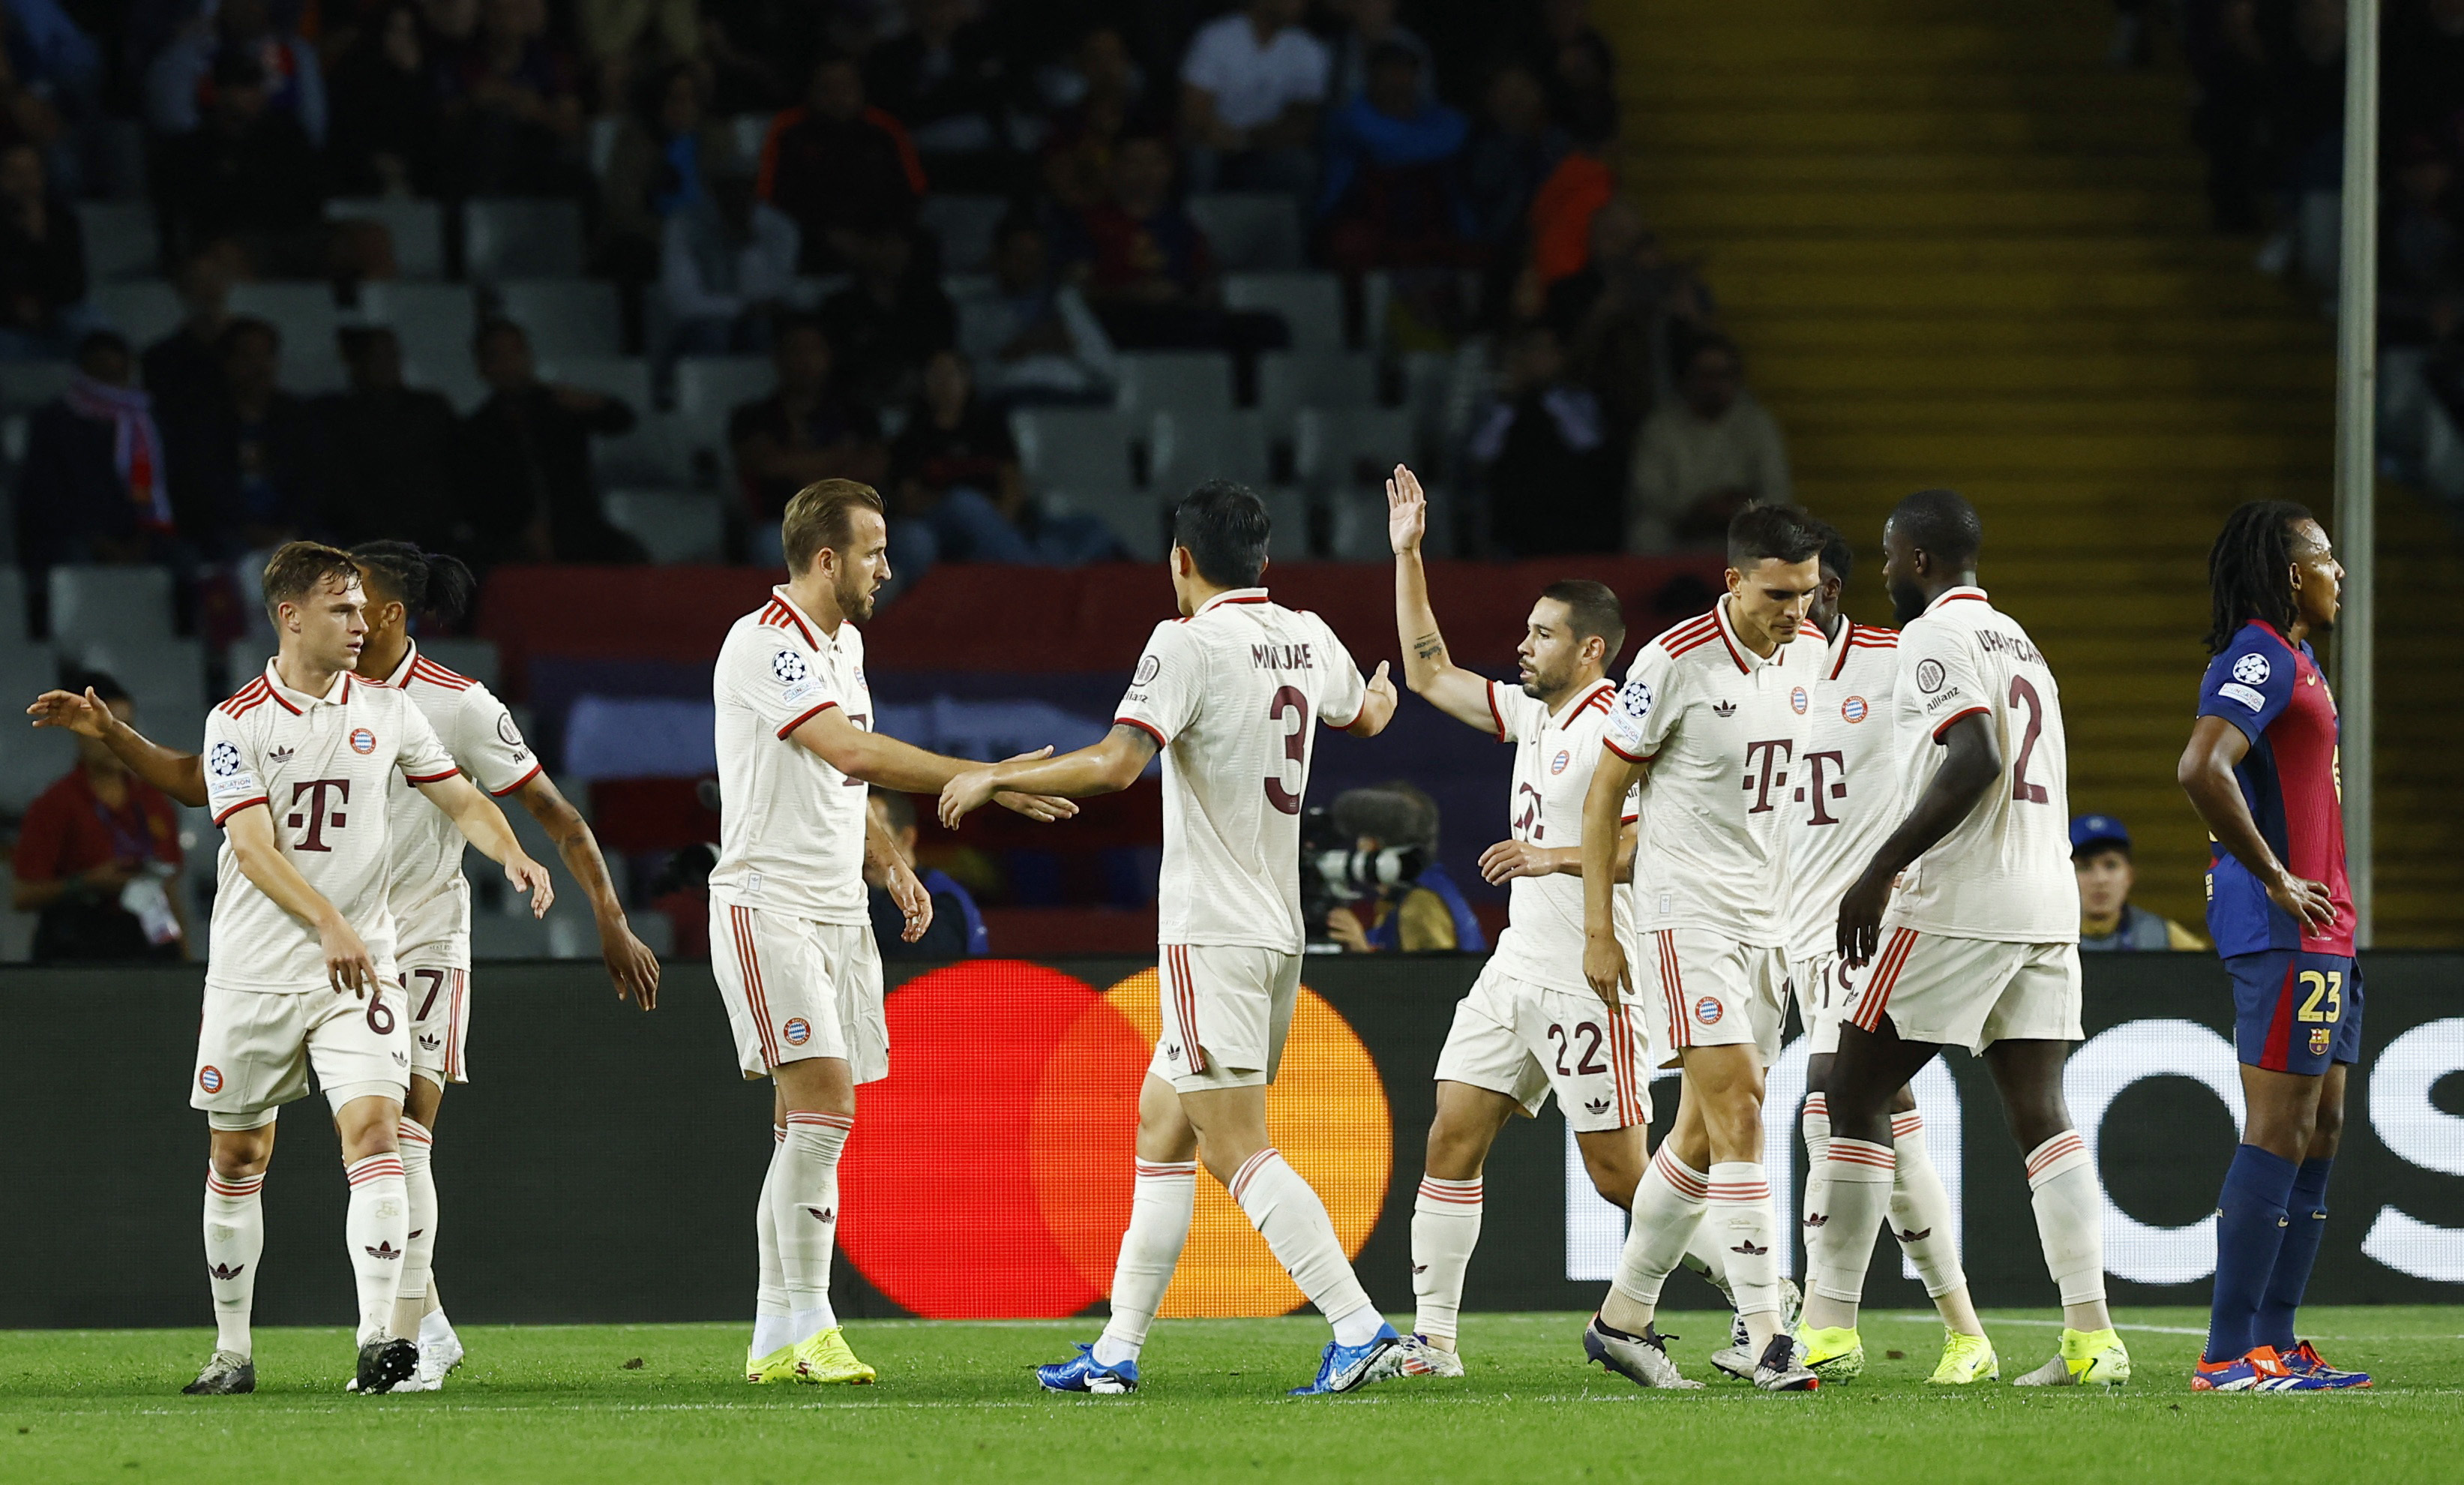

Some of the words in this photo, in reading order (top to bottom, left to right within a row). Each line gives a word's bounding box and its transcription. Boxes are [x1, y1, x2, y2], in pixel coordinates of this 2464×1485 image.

[1251, 644, 1313, 670] MINJAE
[1926, 686, 1960, 714] Allianz
[1263, 686, 1308, 815] 3
[2009, 674, 2049, 806] 2
[1743, 739, 1793, 814] T
[1794, 750, 1847, 826] T
[288, 779, 350, 852] T
[367, 992, 395, 1035] 6
[399, 969, 444, 1022] 7
[2298, 970, 2341, 1023] 23
[1547, 1021, 1608, 1077] 22
